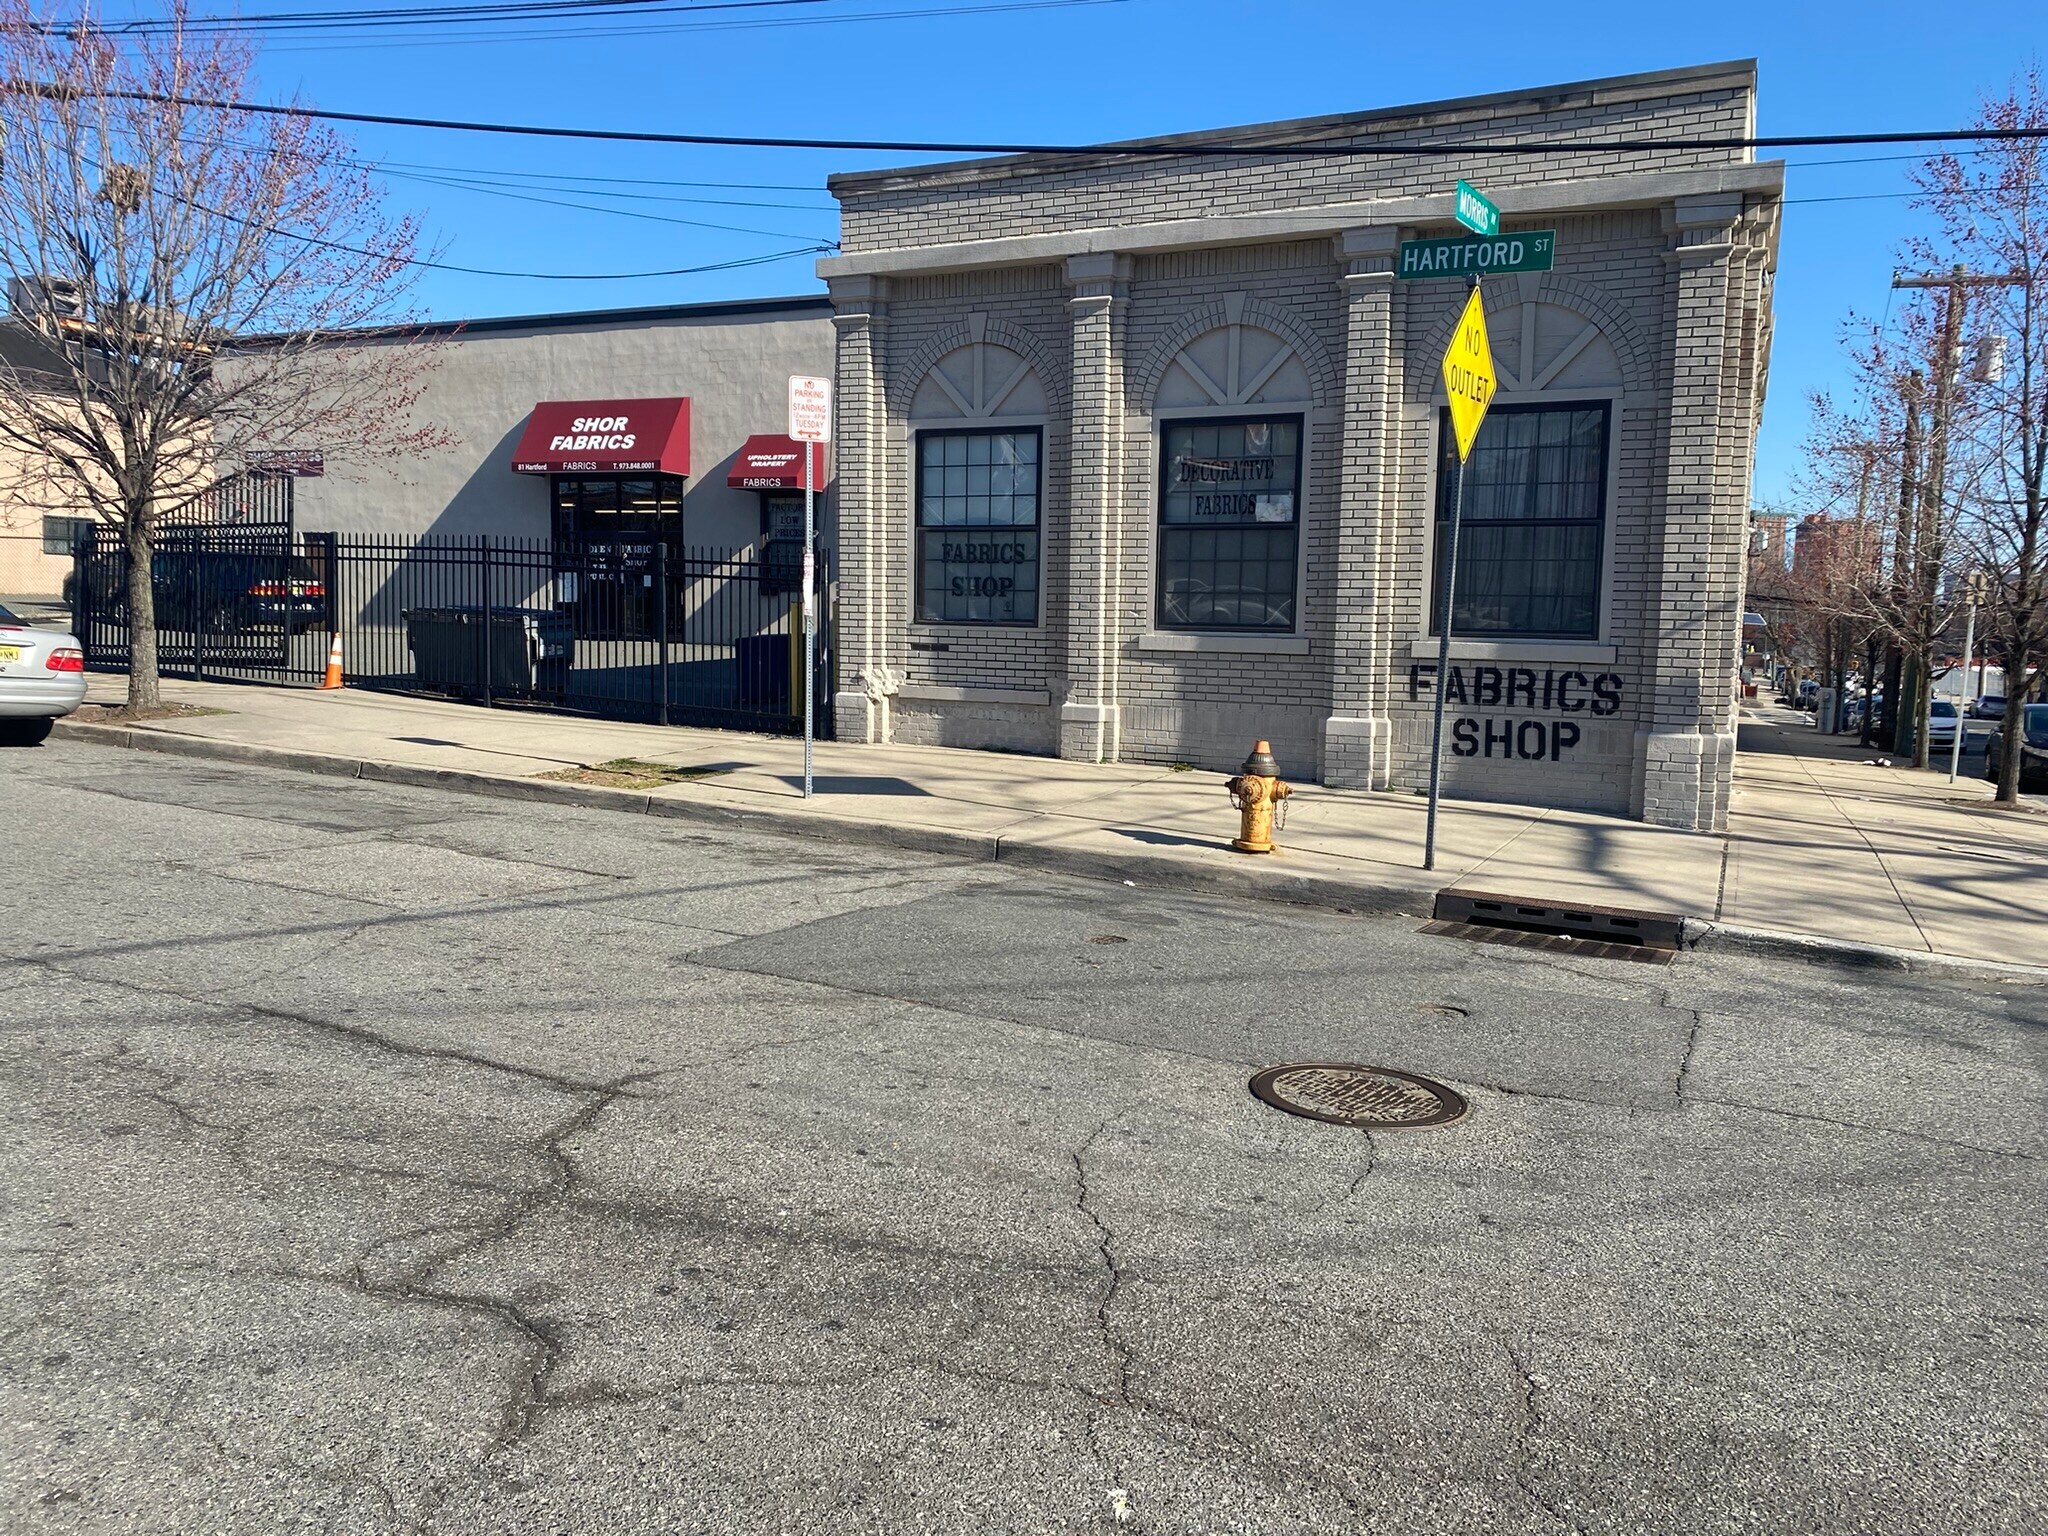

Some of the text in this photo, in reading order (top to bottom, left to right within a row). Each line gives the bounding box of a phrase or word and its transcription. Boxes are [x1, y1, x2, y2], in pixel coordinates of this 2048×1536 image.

[1460, 189, 1489, 231] MORRIS
[1403, 238, 1550, 272] HARTFORD ST
[1465, 325, 1480, 357] NO
[804, 381, 815, 389] NO
[1451, 364, 1489, 405] OUTLET
[794, 389, 824, 399] PARKING
[792, 403, 827, 413] STANDING
[571, 416, 629, 432] SHOR
[795, 419, 825, 428] TUESDAY
[549, 434, 636, 450] FABRICS
[525, 463, 548, 471] Hartford
[562, 461, 597, 471] FABRICS
[618, 462, 655, 470] 973.848.0001
[1180, 459, 1274, 482] DECORATIVE
[743, 478, 781, 487] FABRICS
[1195, 493, 1257, 516] FABRICS
[780, 516, 800, 525] LOW
[774, 528, 806, 537] PRICES
[941, 542, 1026, 565] FABRICS
[951, 575, 1014, 598] SHOP
[1409, 664, 1624, 716] FABRICS
[1451, 718, 1581, 762] SHOP
